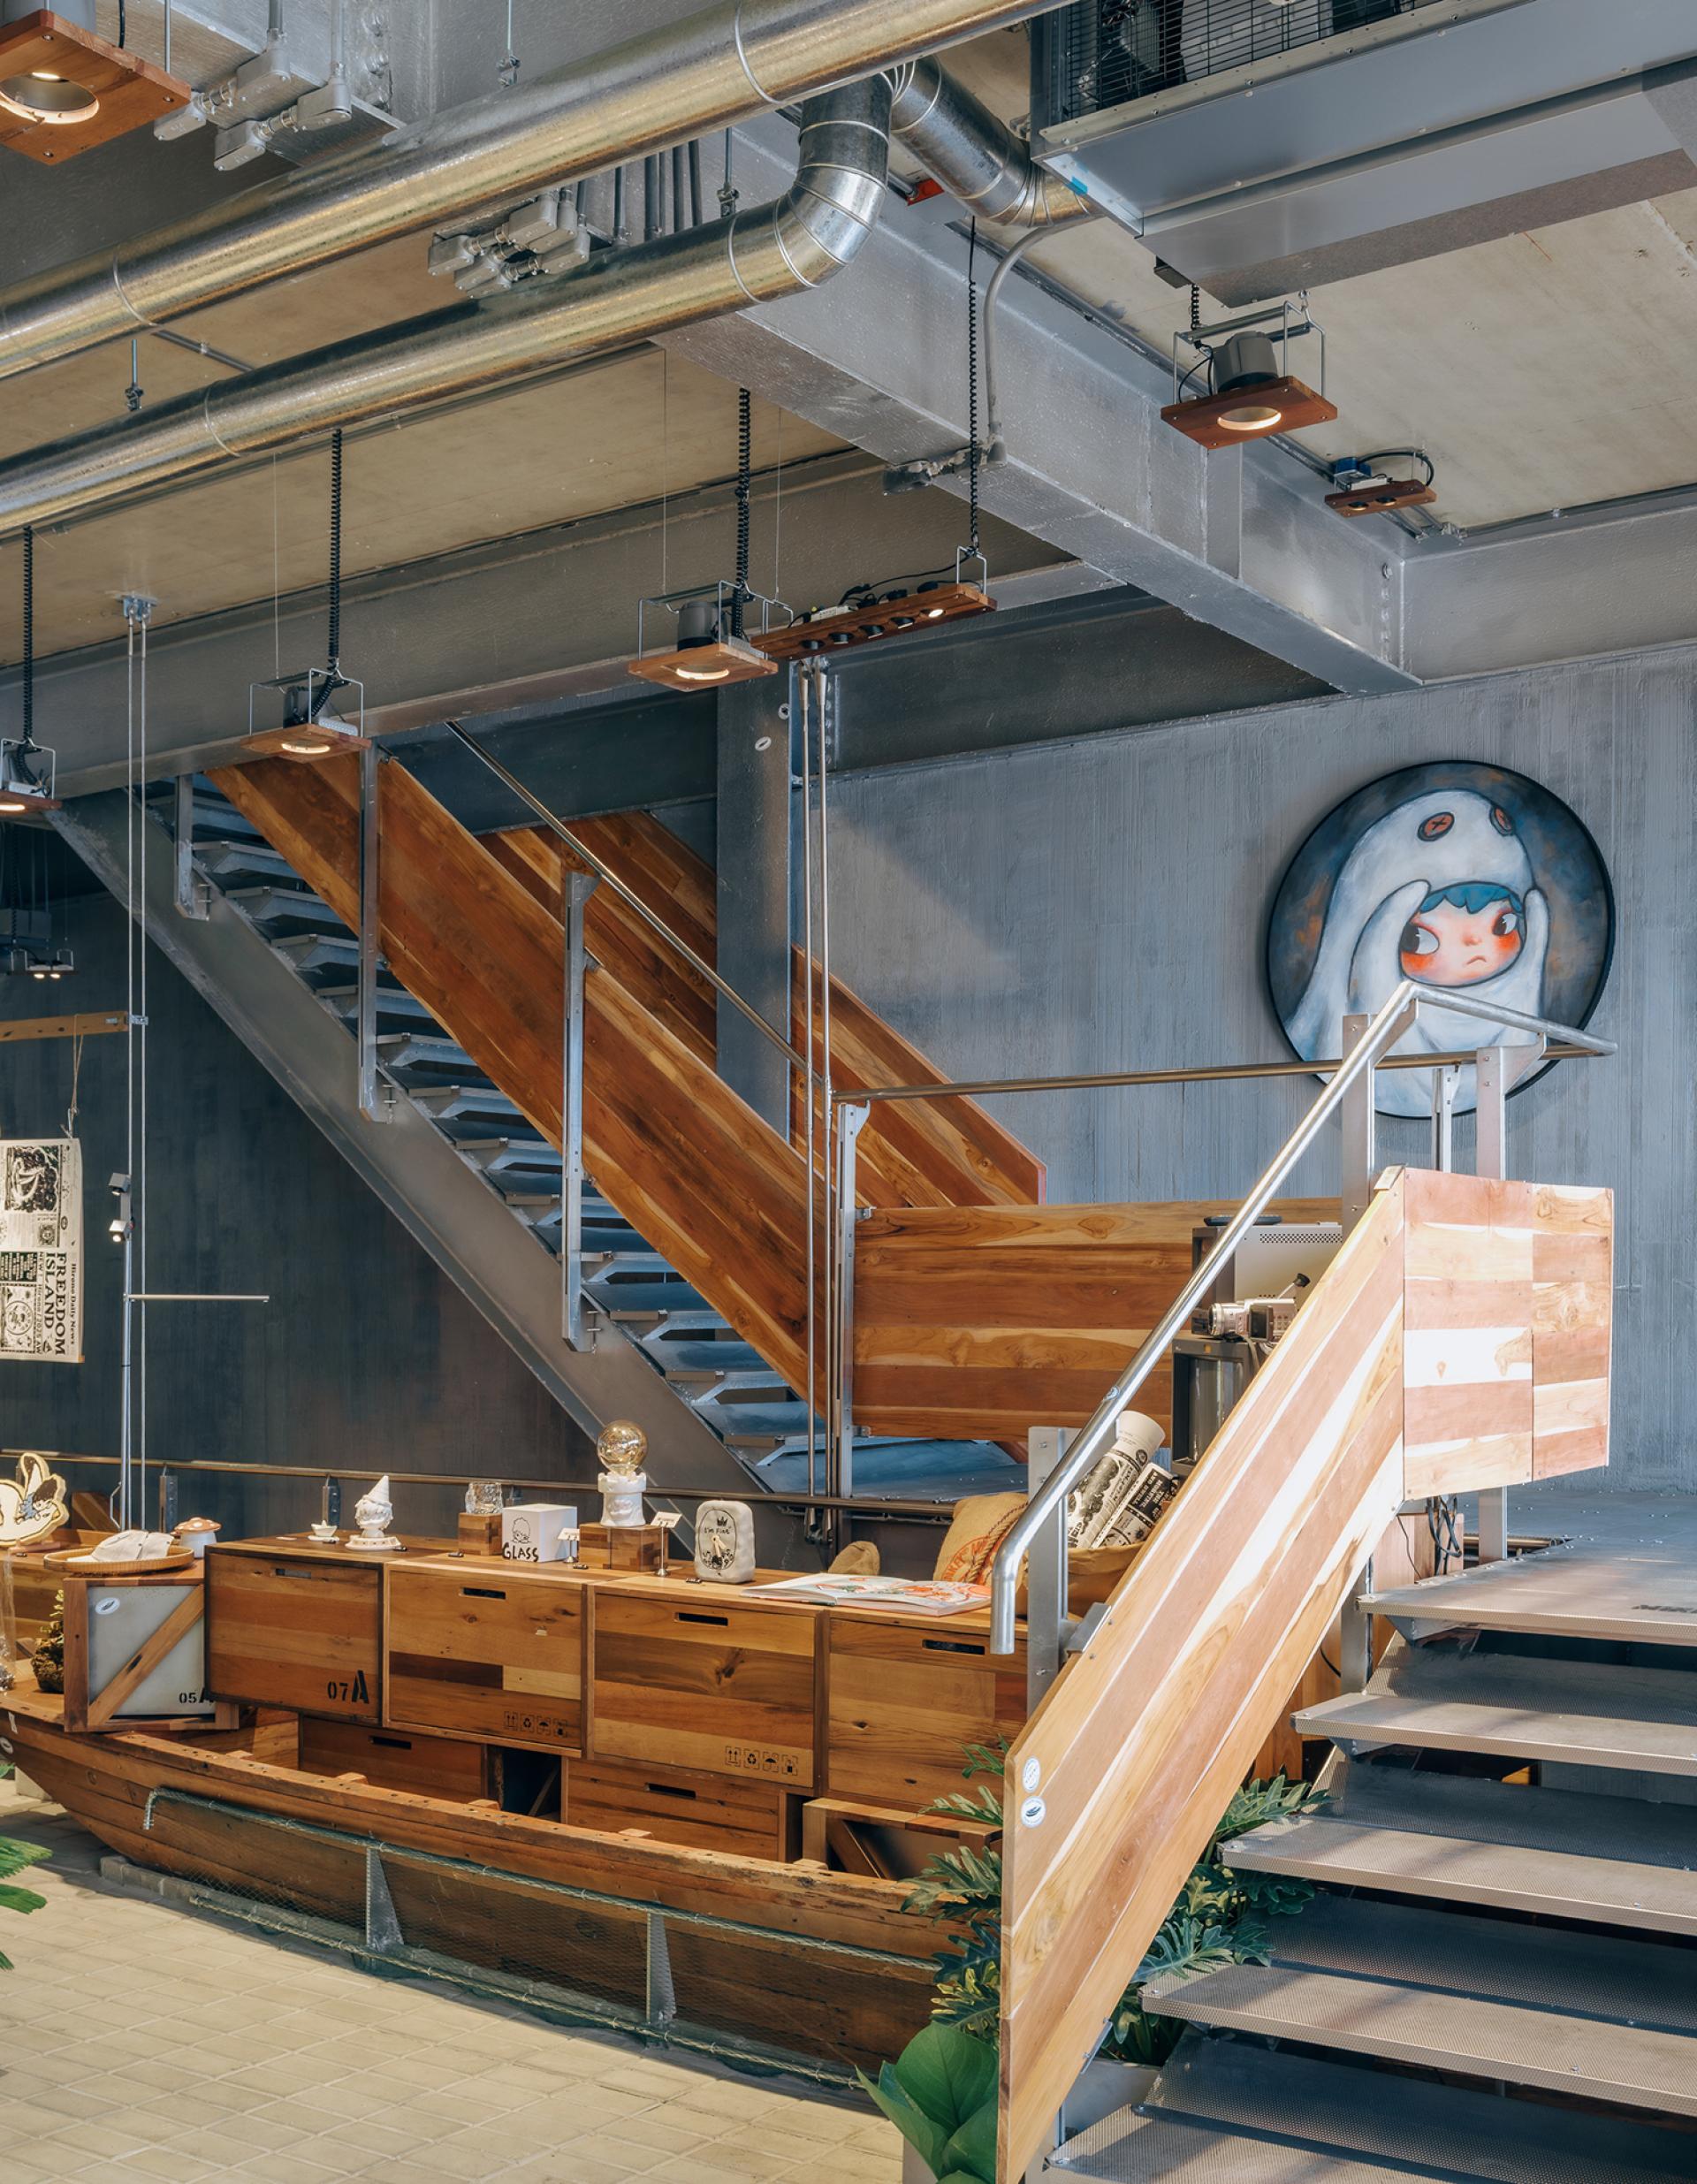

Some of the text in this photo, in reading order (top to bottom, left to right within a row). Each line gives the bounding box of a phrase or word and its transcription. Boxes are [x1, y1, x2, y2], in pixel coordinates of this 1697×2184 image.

[44, 1252, 56, 1329] ISLAND
[55, 1252, 67, 1356] FREEDOM
[502, 1541, 539, 1563] GLASS
